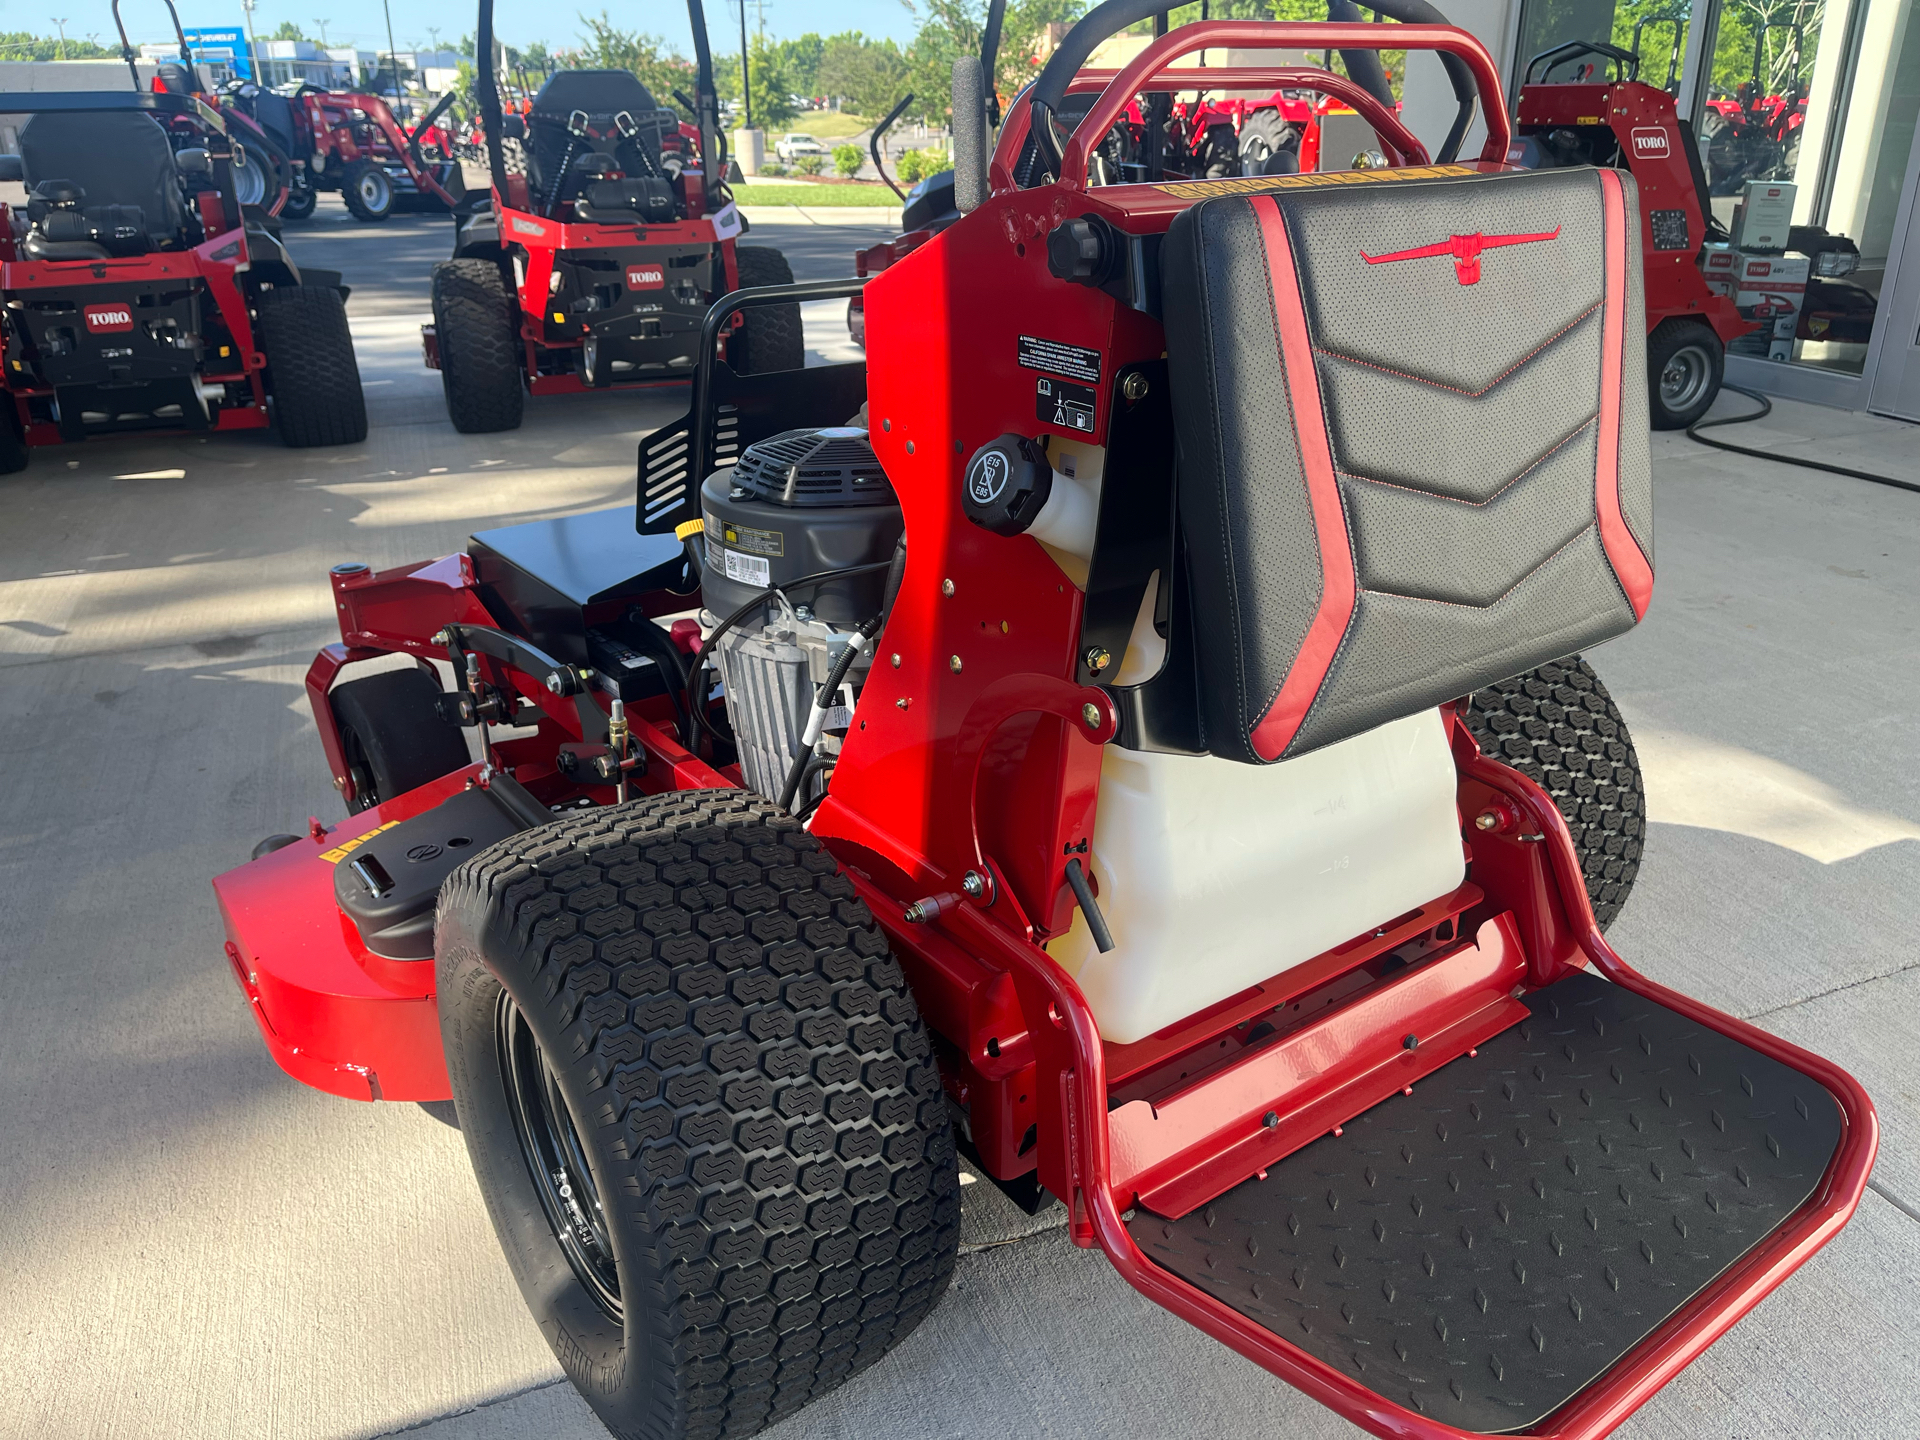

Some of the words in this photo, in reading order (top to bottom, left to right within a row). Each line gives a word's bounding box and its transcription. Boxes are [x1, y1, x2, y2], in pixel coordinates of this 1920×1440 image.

[1635, 137, 1666, 149] TORO
[1749, 265, 1769, 273] TORO
[628, 271, 663, 284] TORO
[88, 311, 130, 326] TORO
[987, 456, 1001, 468] E15
[975, 485, 988, 497] E85
